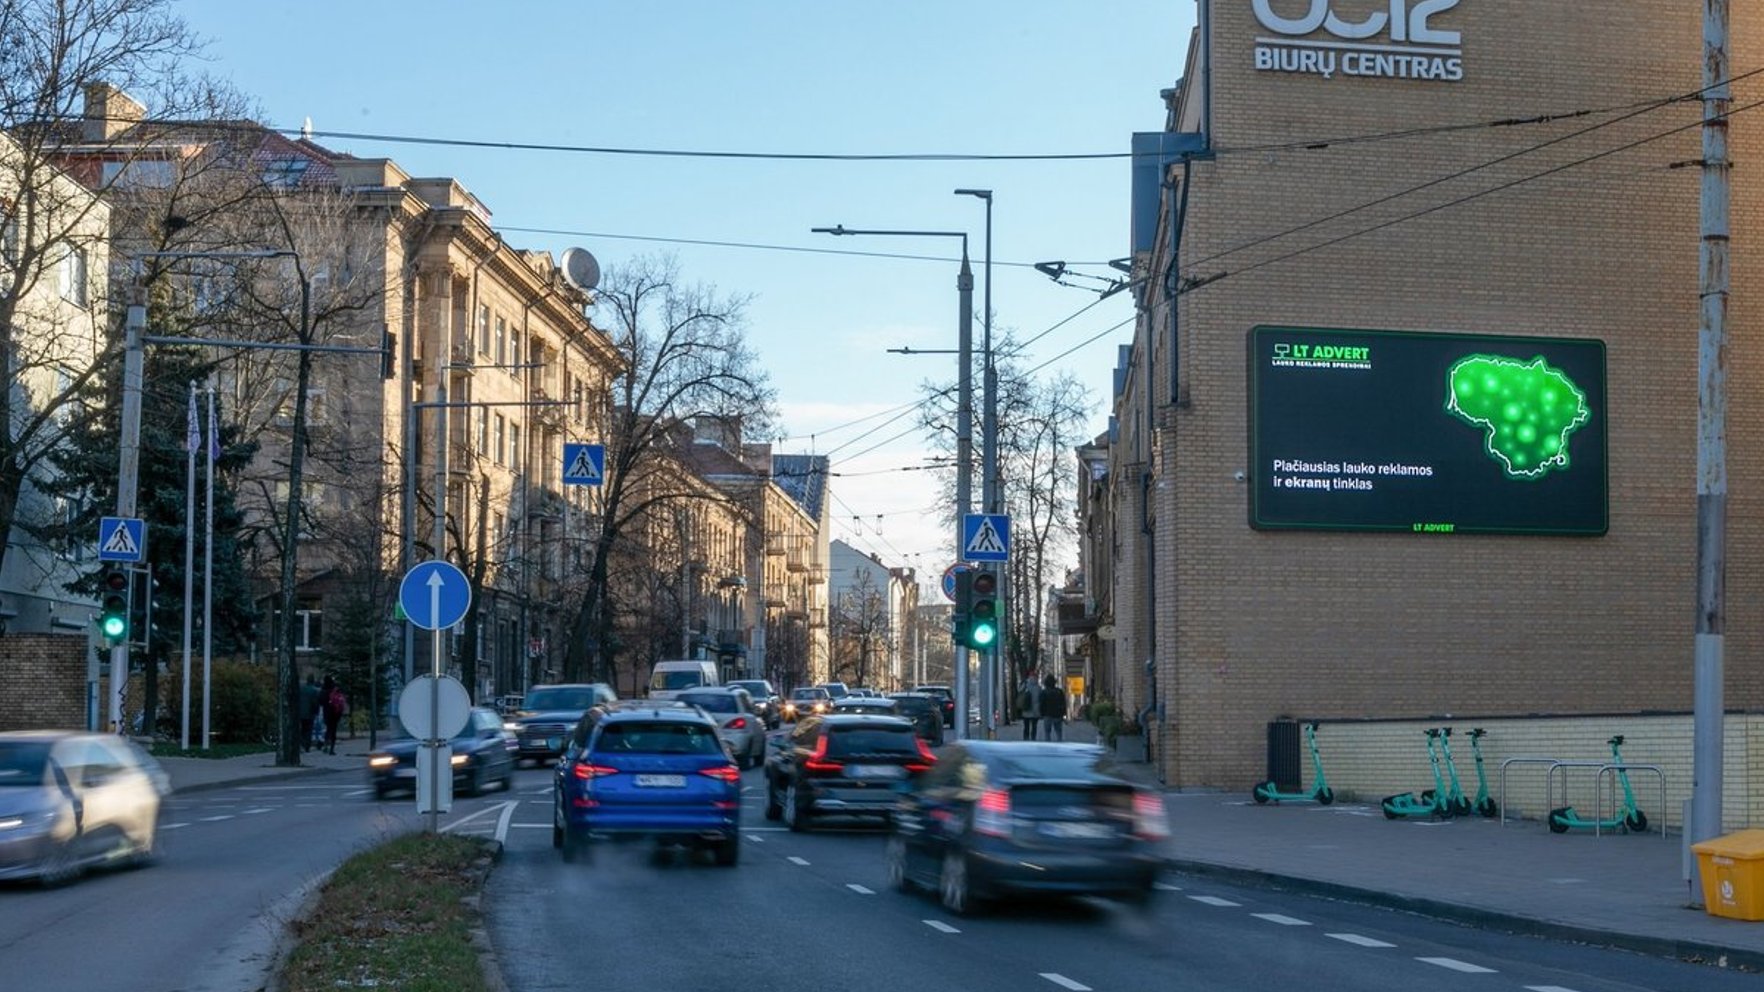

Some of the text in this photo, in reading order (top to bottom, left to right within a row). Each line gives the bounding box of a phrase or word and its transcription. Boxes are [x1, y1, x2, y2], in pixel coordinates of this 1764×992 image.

[1255, 47, 1463, 80] BIURŲ CENTRAS
[1293, 344, 1370, 360] LT ADVERT
[1273, 459, 1433, 476] Plačiausias lauko reklamos
[1273, 475, 1373, 491] ir ekranų tinklas
[1413, 523, 1455, 533] LT ADVERT
